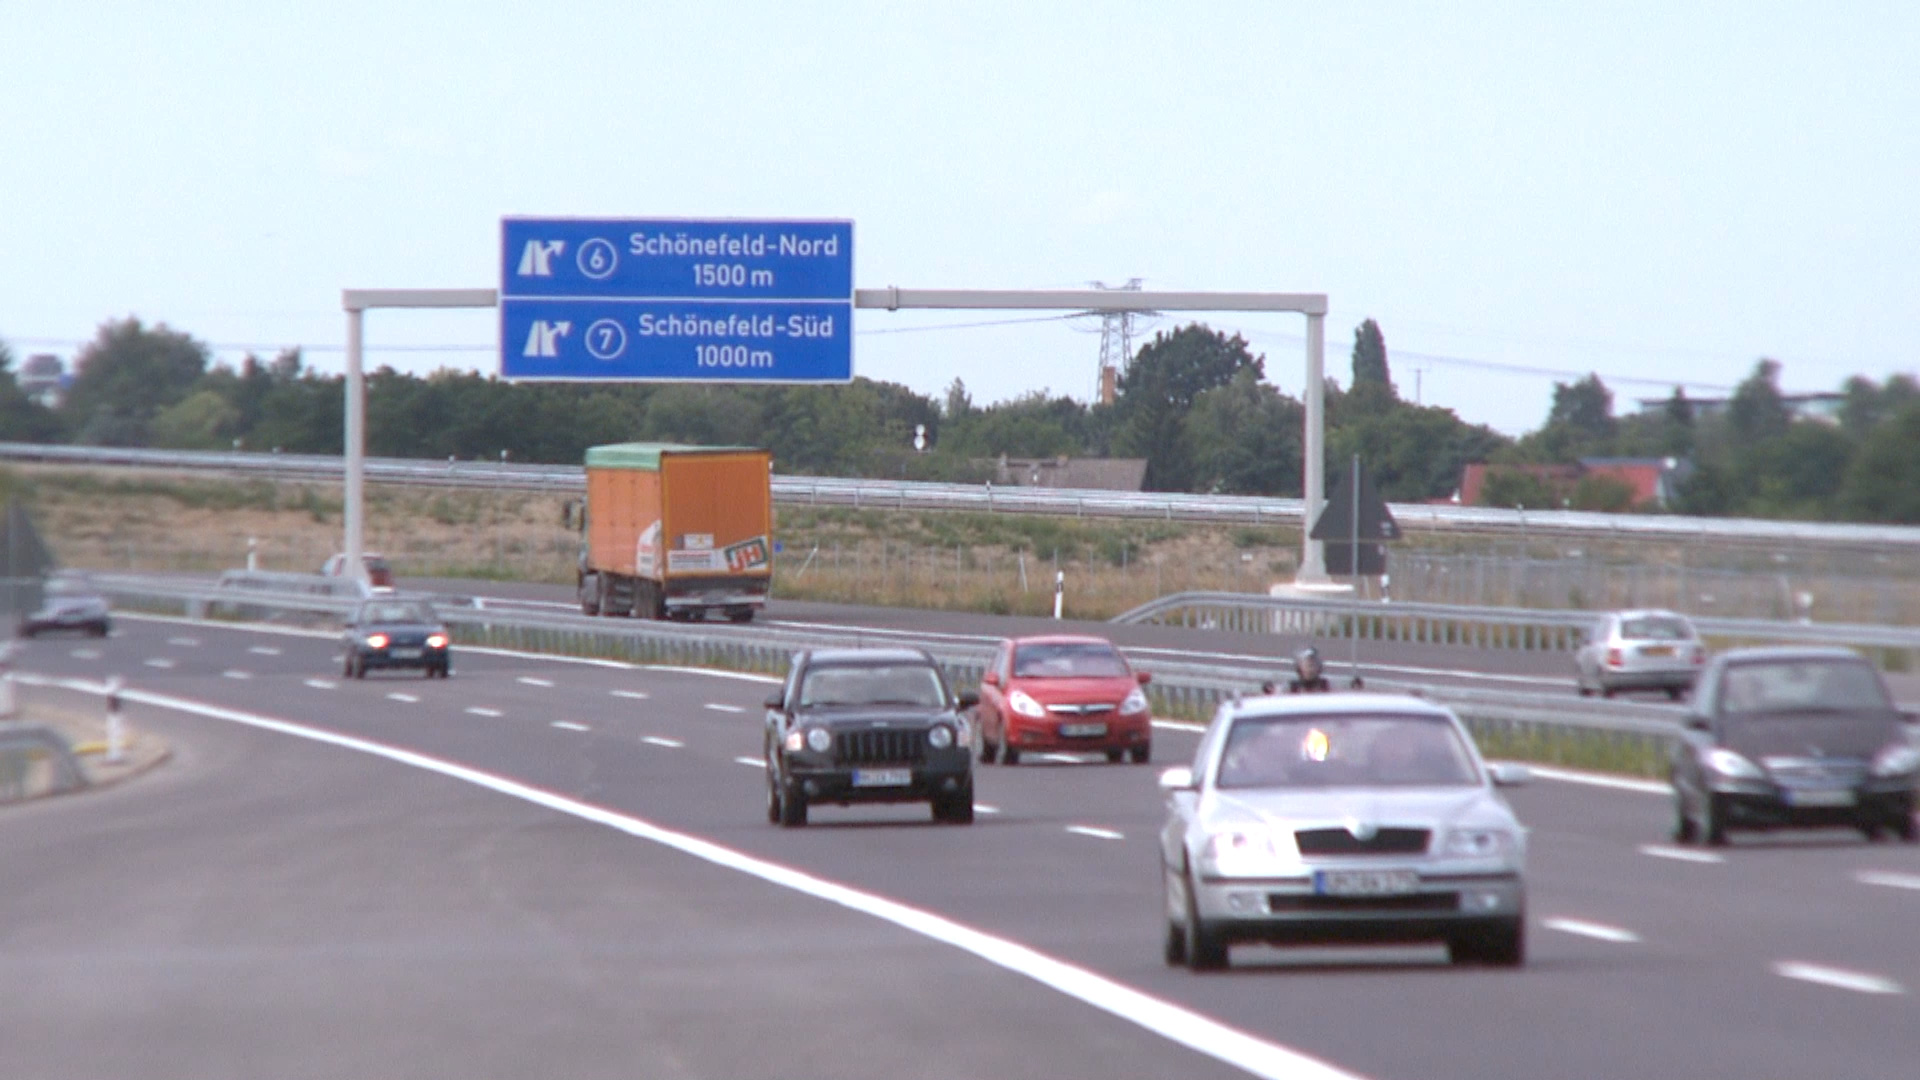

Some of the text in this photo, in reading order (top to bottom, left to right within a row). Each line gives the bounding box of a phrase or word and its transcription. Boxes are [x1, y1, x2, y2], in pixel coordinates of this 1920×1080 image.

[629, 233, 838, 256] Schönefeld-Nord
[589, 248, 605, 269] 6
[693, 264, 773, 286] 1500 m
[638, 314, 834, 337] Schönefeld-Süd
[598, 329, 614, 351] 7
[695, 345, 773, 367] 1000 m
